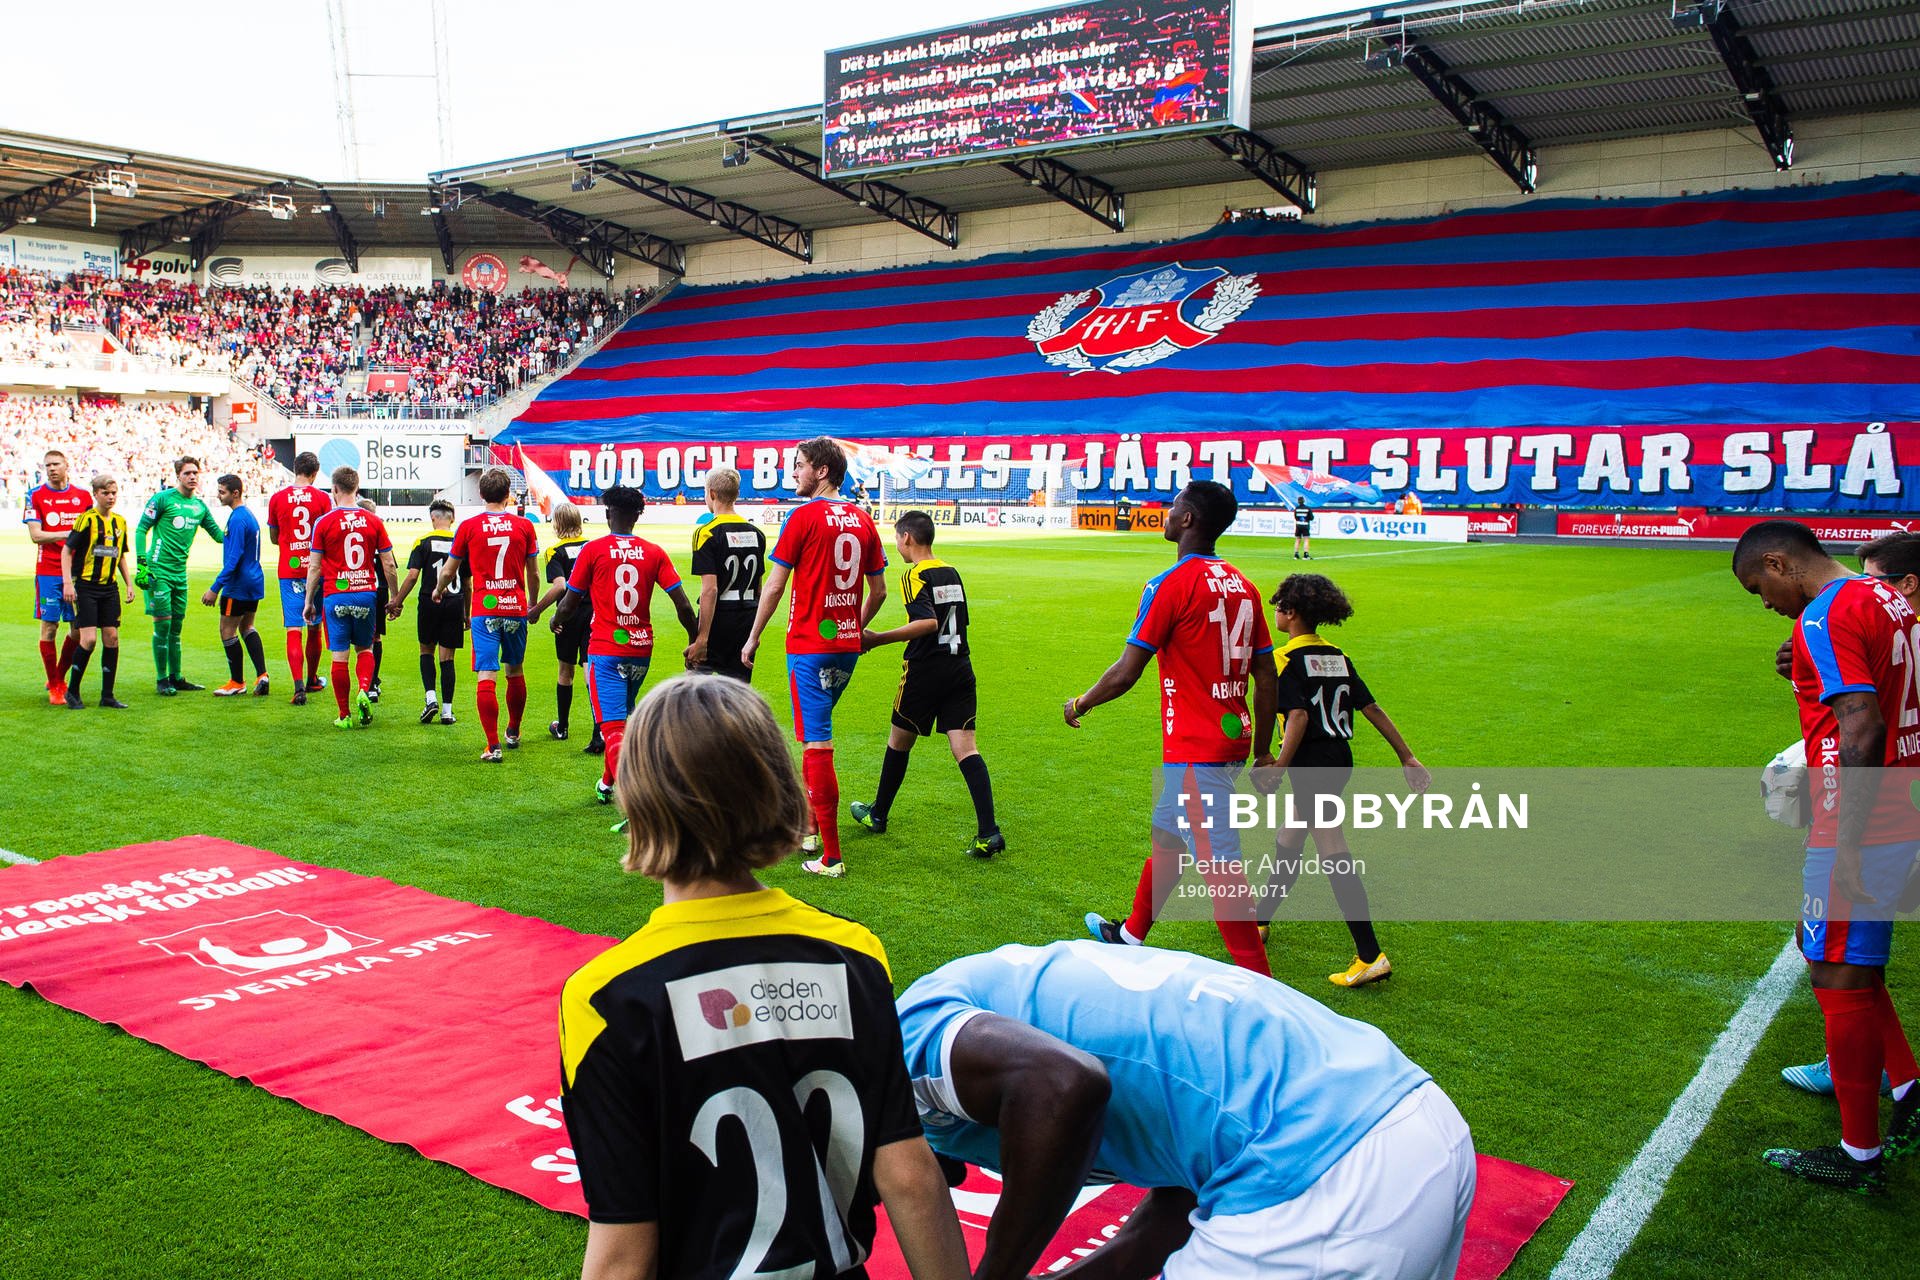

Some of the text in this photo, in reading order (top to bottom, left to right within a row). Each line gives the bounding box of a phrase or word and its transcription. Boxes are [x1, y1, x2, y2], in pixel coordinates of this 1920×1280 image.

[839, 16, 1087, 73] Det är kärlek ikväll syster och bror
[839, 40, 1119, 101] Det är bultande hjärtan och slitna skor
[839, 110, 865, 127] Och
[867, 104, 892, 123] när
[894, 88, 989, 119] strålkastaren
[991, 78, 1056, 103] slocknar
[1164, 58, 1185, 81] gå
[839, 118, 981, 155] På gator röda och blå
[84, 251, 112, 263] Paras
[152, 258, 190, 275] golv
[252, 272, 309, 281] CASTELLUM
[366, 273, 422, 281] CASTELLUM
[367, 440, 442, 458] Resurs
[568, 443, 645, 490] RÖD
[656, 445, 738, 490] OCH
[1028, 433, 1346, 493] HJÄRTAT
[1369, 432, 1692, 493] SLUTAR
[1721, 422, 1902, 496] SLÅ
[367, 462, 420, 480] Bank
[288, 493, 312, 505] inyett
[292, 505, 312, 540] 3
[340, 516, 368, 532] inyett
[482, 519, 513, 535] inyett
[824, 510, 862, 532] inyett
[1038, 513, 1070, 525] drrar.
[1079, 510, 1111, 526] min
[1361, 516, 1427, 538] Vägen
[343, 532, 365, 570] 6
[487, 535, 510, 580] 7
[609, 545, 645, 563] inyett
[834, 532, 862, 590] 9
[485, 579, 517, 590] RANDRUP
[614, 563, 639, 614] 8
[719, 553, 758, 601] 22
[1204, 571, 1247, 599] inyett
[498, 595, 518, 604] Solid
[937, 605, 962, 655] 4
[1208, 597, 1254, 676] 14
[1310, 683, 1353, 738] 16
[1821, 736, 1840, 790] akea
[0, 881, 166, 921] ramåt
[0, 866, 319, 941] vensk fotboll!
[1803, 893, 1823, 919] 20
[178, 931, 494, 1011] SVENSKA SPEL
[750, 977, 823, 1000] dieden
